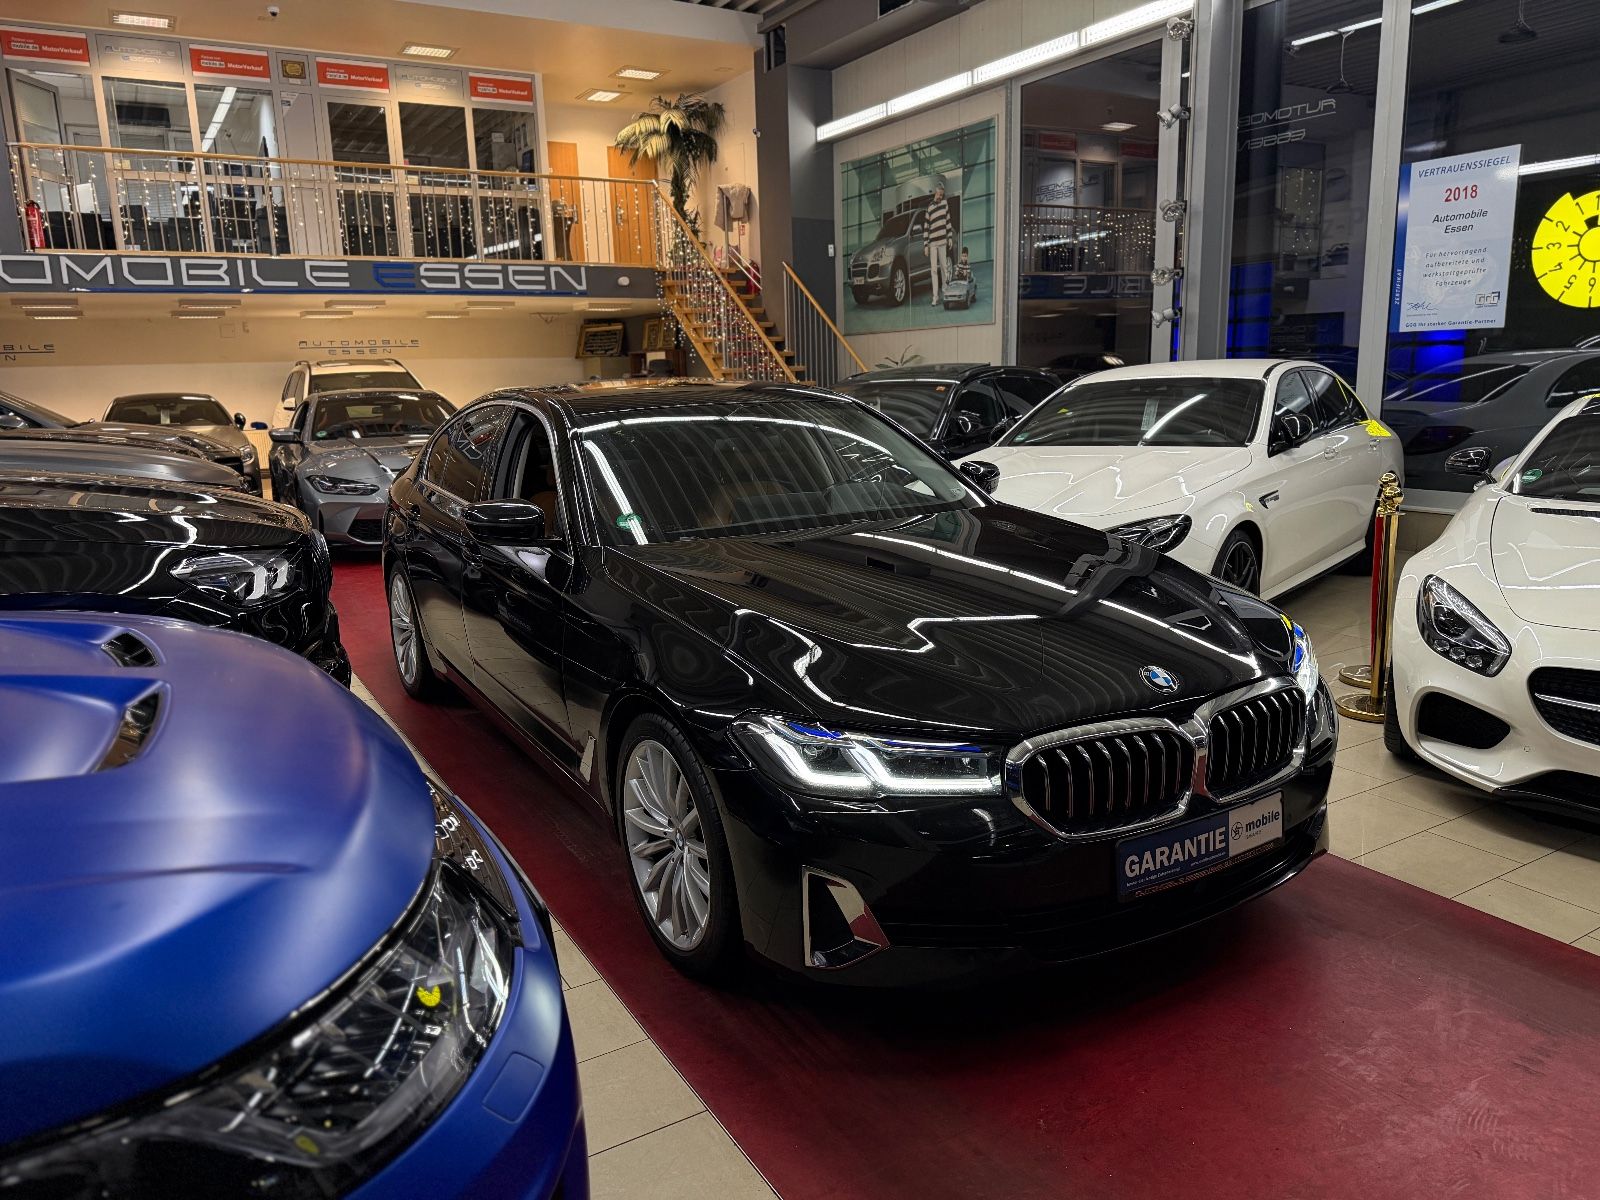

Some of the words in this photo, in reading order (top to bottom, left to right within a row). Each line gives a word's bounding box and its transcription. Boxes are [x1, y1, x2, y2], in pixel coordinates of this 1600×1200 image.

[42, 45, 83, 54] MotorVerkauf
[228, 62, 264, 71] MotorVerkauf
[1418, 155, 1511, 178] VERTRAUENSSIEGEL
[1444, 184, 1478, 203] 2018
[1575, 202, 1585, 215] 1
[1432, 208, 1488, 223] Automobile
[1444, 224, 1474, 234] Essen
[1556, 220, 1571, 232] 2
[1438, 247, 1487, 257] hervorragend
[1546, 242, 1562, 250] 3
[1549, 262, 1563, 272] 4
[372, 263, 587, 290] ESSEN
[1563, 274, 1577, 290] 5
[1435, 279, 1472, 287] Fahrzeuge
[298, 339, 420, 347] AUTOMOBILE
[1245, 810, 1280, 833] mobile
[1125, 827, 1226, 878] GARANTIE
